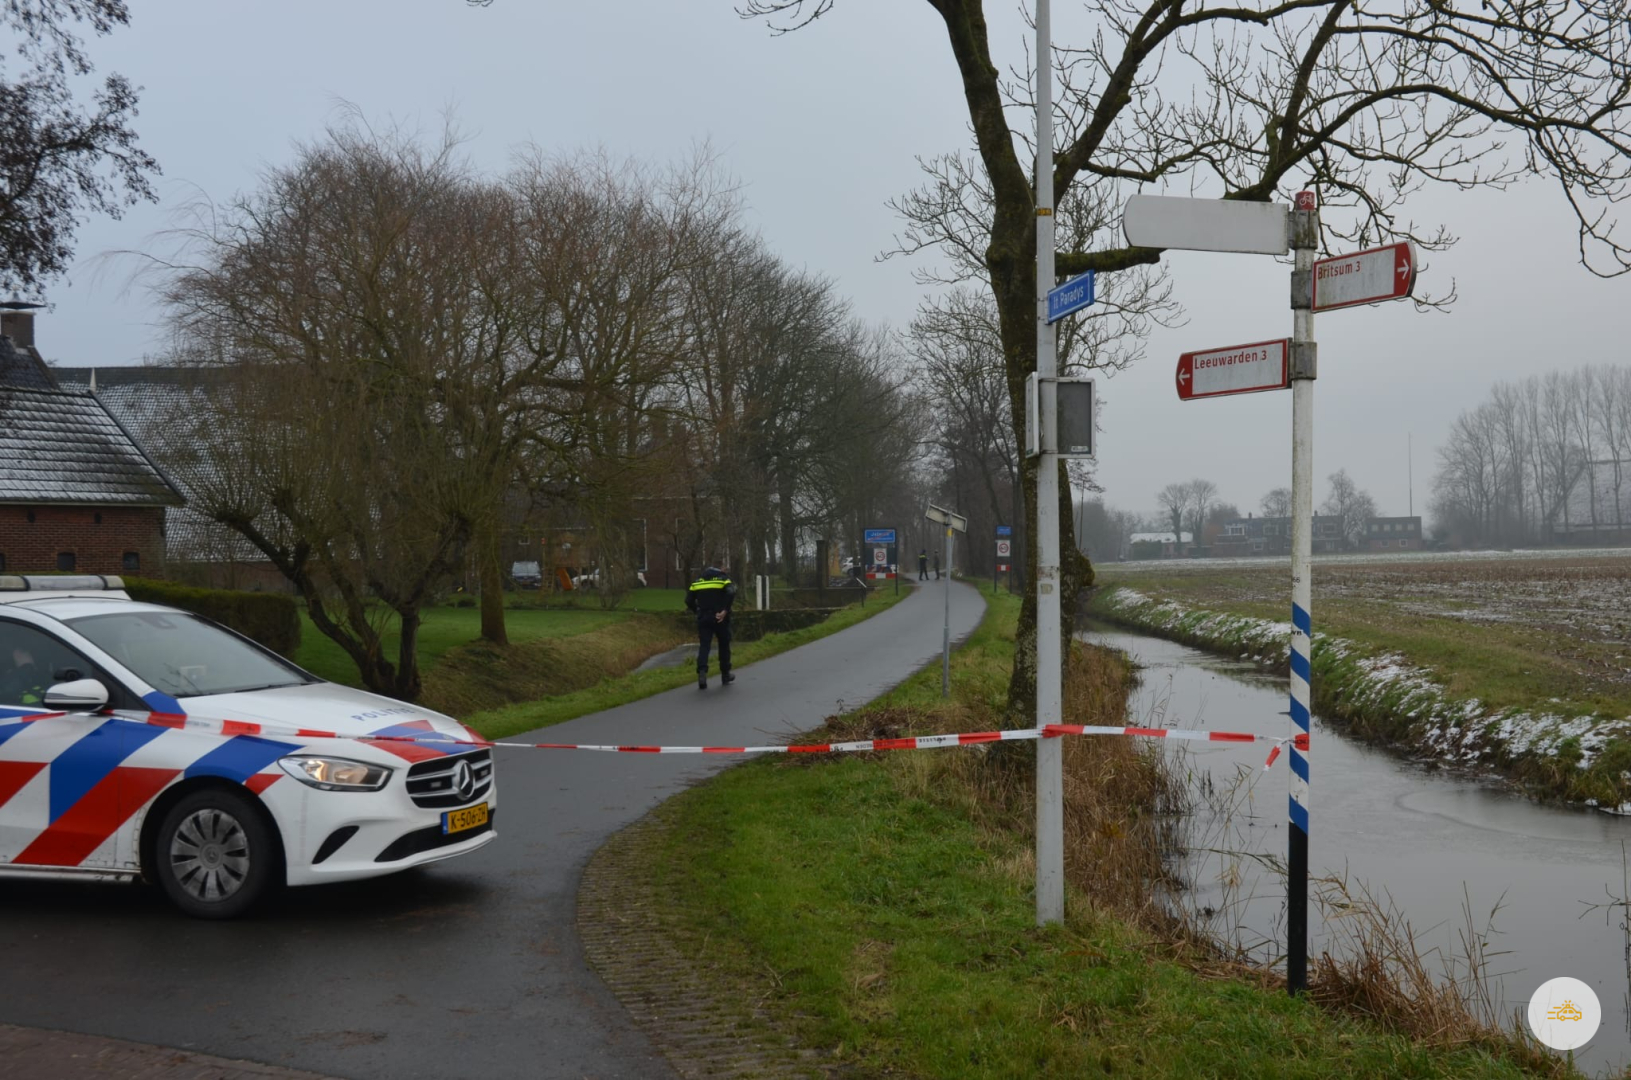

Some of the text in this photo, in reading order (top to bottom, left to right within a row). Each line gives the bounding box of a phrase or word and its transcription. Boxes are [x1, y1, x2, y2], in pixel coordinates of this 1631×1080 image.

[1317, 260, 1362, 280] Britsum 3
[1060, 285, 1084, 307] Paradys
[1194, 349, 1268, 370] Leeuwarden 3
[350, 707, 416, 721] POLITIE
[451, 806, 486, 830] K-506-ZH
